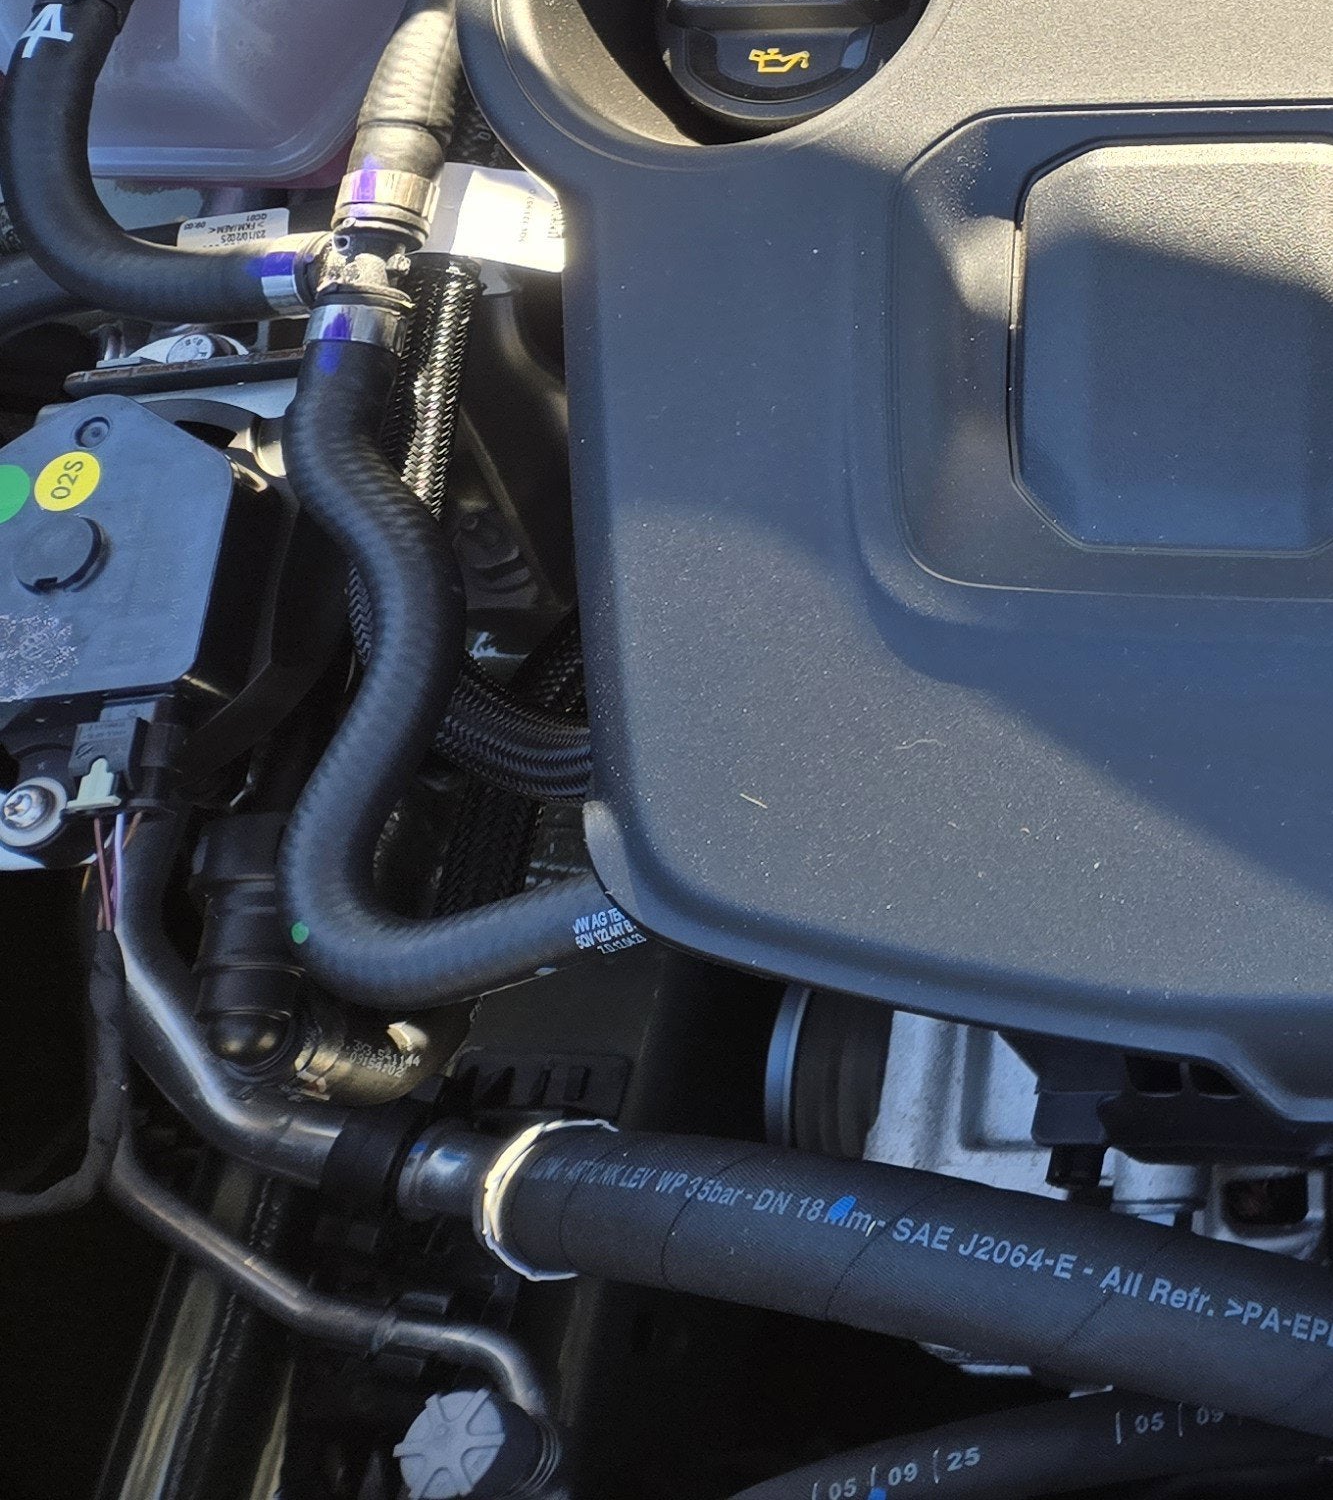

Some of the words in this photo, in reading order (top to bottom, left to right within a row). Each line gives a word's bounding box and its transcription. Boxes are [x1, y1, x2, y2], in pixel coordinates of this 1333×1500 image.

[572, 917, 589, 934] VW
[592, 911, 607, 929] AG
[619, 1164, 656, 1190] LEV
[655, 1170, 688, 1194] WP
[685, 1175, 744, 1206] 35bar
[753, 1189, 793, 1215] DN
[892, 1216, 955, 1251] SAE
[958, 1232, 1078, 1280] J2064-E
[1100, 1265, 1143, 1298] All
[1148, 1277, 1215, 1318] Refr.
[1135, 1412, 1165, 1433] 05
[828, 1478, 858, 1499] 05
[888, 1463, 918, 1486] 09
[945, 1446, 981, 1472] 25
